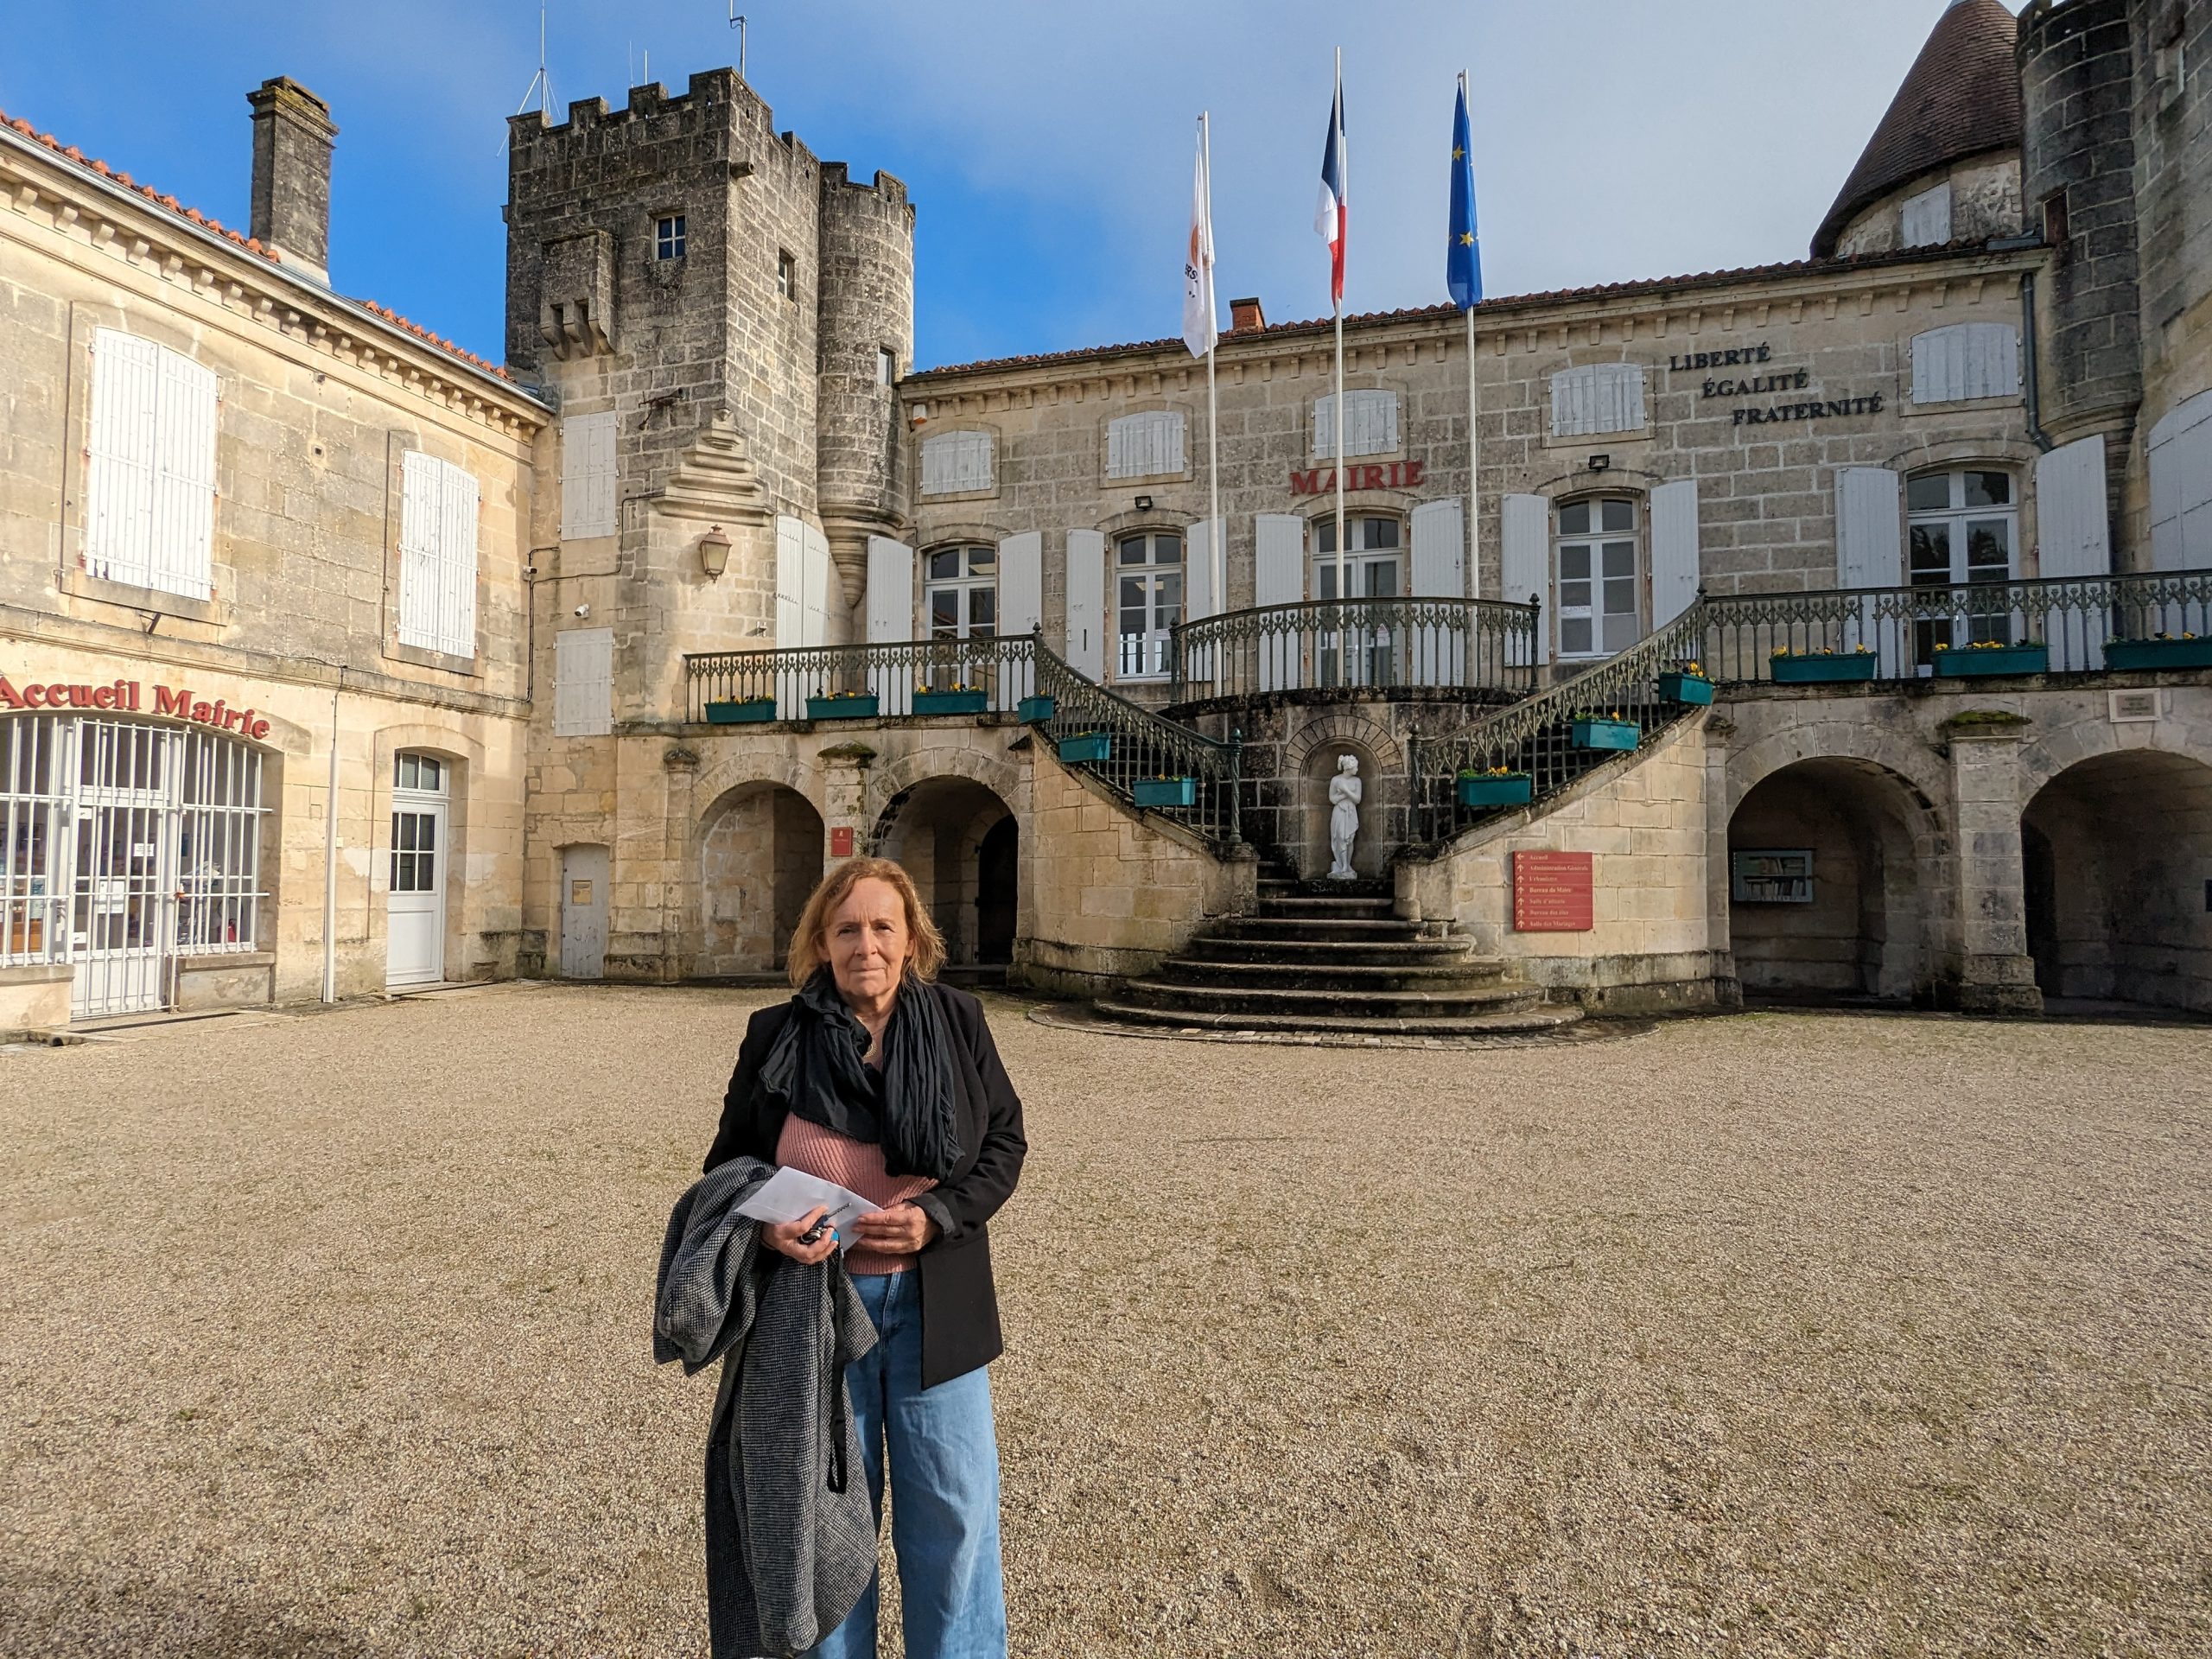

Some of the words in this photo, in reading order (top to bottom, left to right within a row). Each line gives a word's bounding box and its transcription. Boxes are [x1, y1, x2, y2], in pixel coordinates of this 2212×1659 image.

[1669, 342, 1770, 372] LIBERTÉ
[1701, 368, 1808, 398] ÉGALITÉ
[1732, 391, 1883, 425] FRATERNITÉ
[1290, 460, 1424, 496] MAIRIE
[0, 677, 141, 711] Accueil
[152, 685, 270, 740] Mairie
